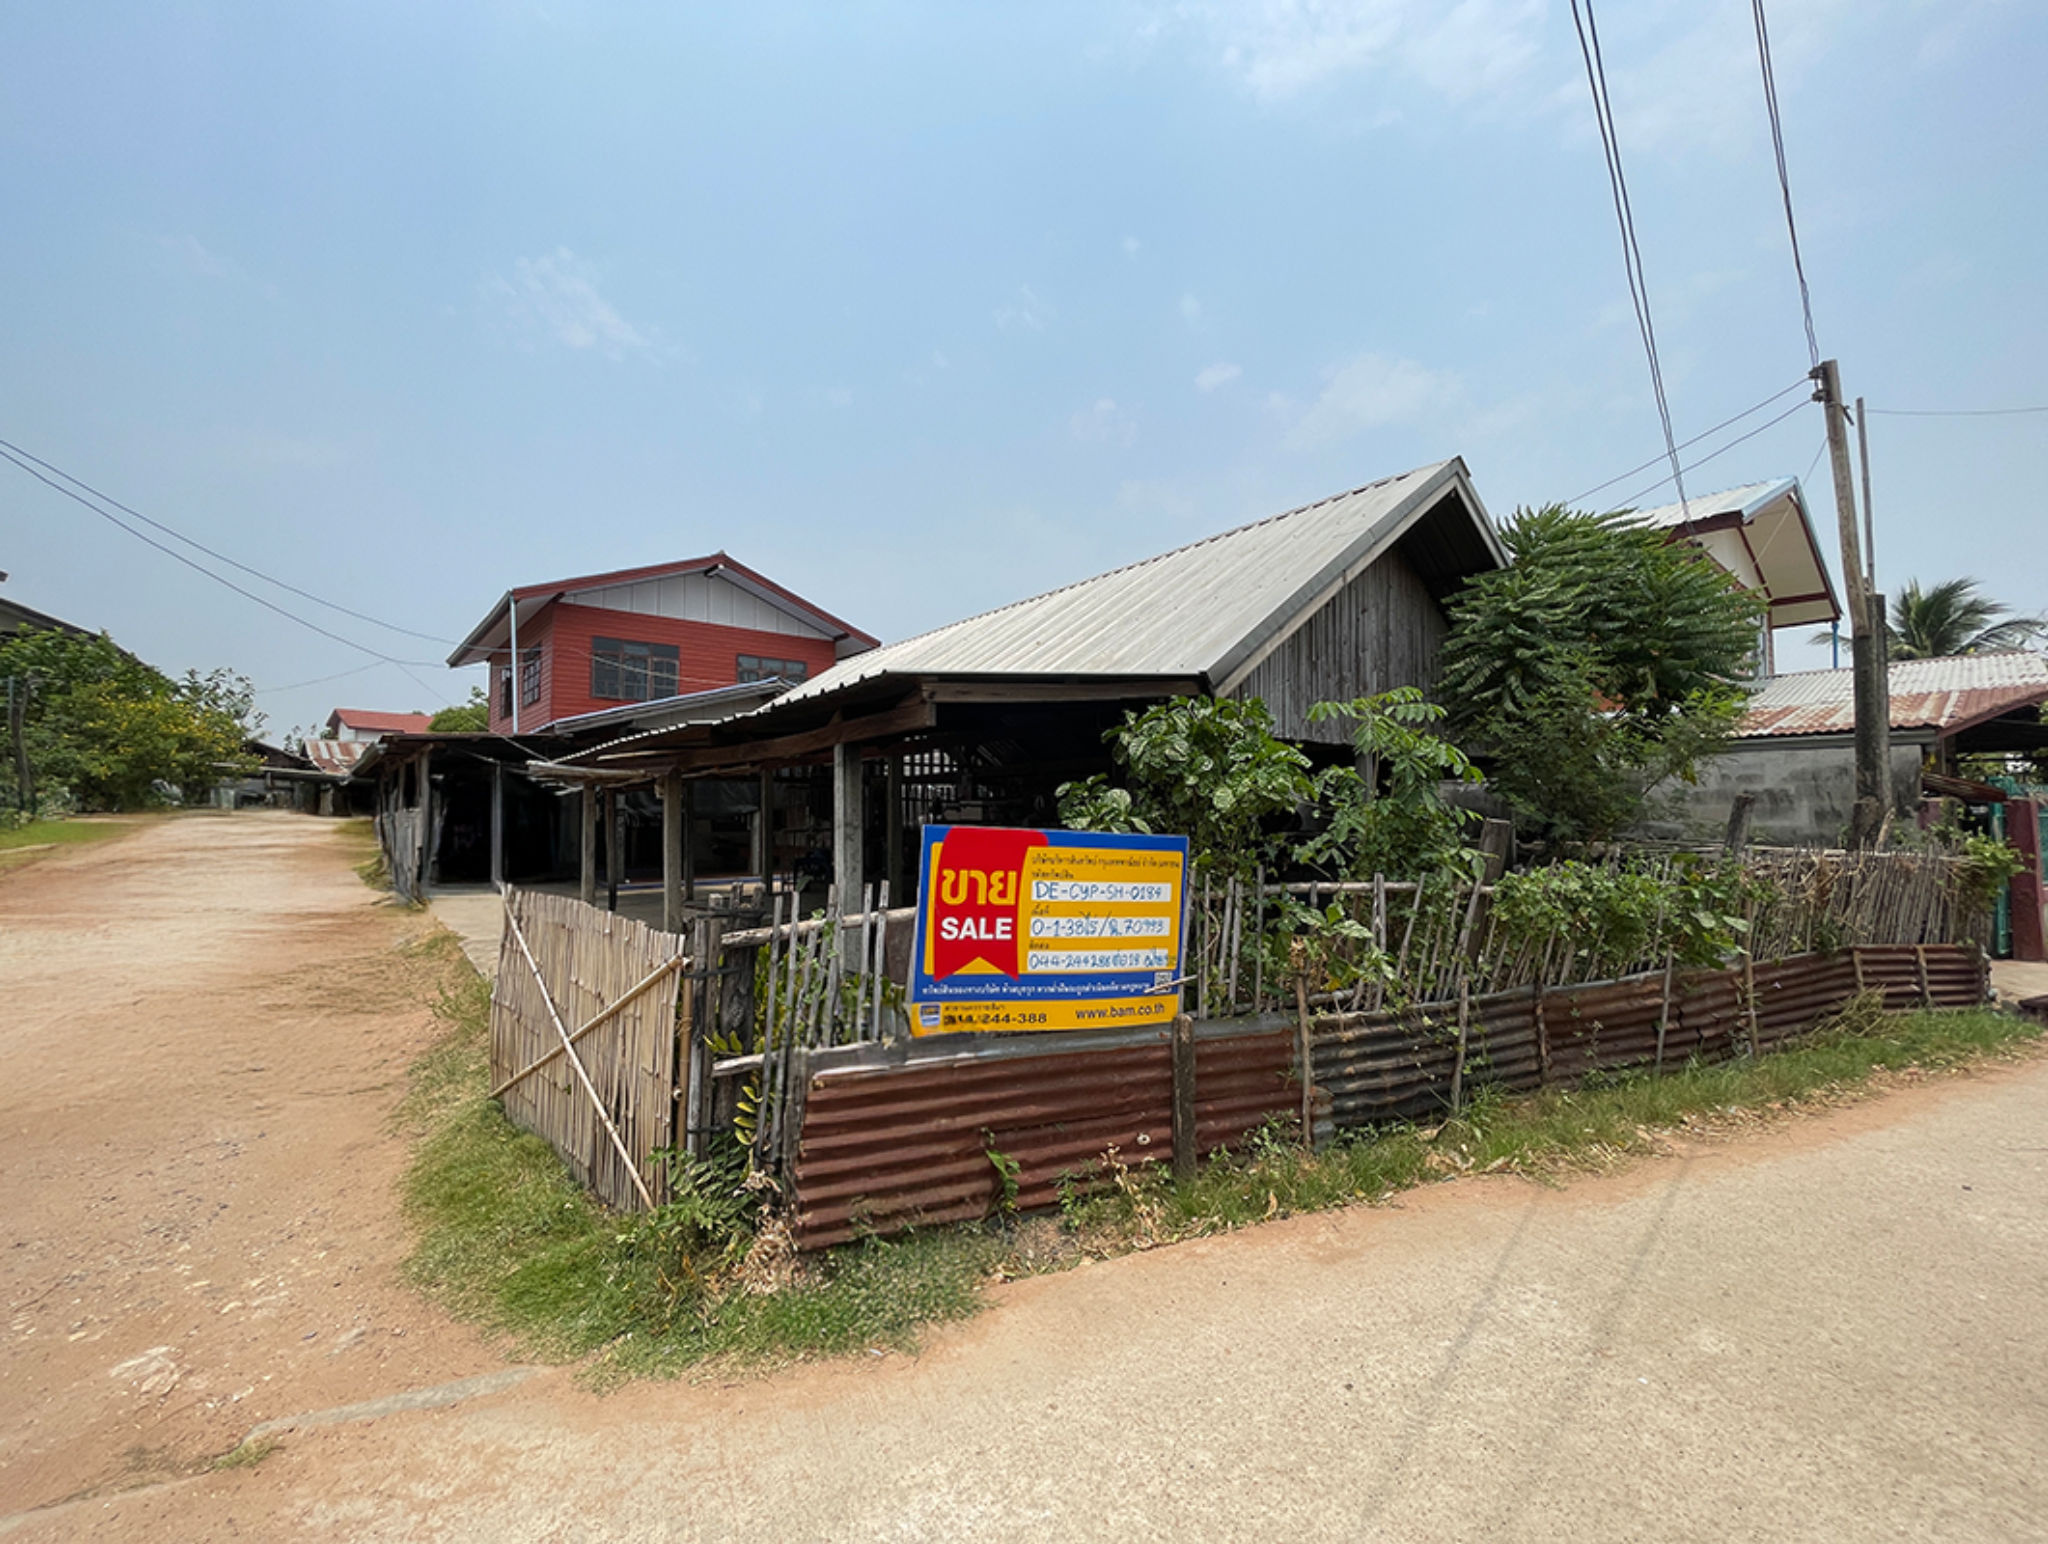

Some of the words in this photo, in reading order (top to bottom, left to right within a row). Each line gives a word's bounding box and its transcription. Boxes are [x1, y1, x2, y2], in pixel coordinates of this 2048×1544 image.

[941, 869, 1017, 905] ขาย
[940, 917, 1013, 940] SALE
[1075, 1003, 1165, 1020] www.bam.co.th
